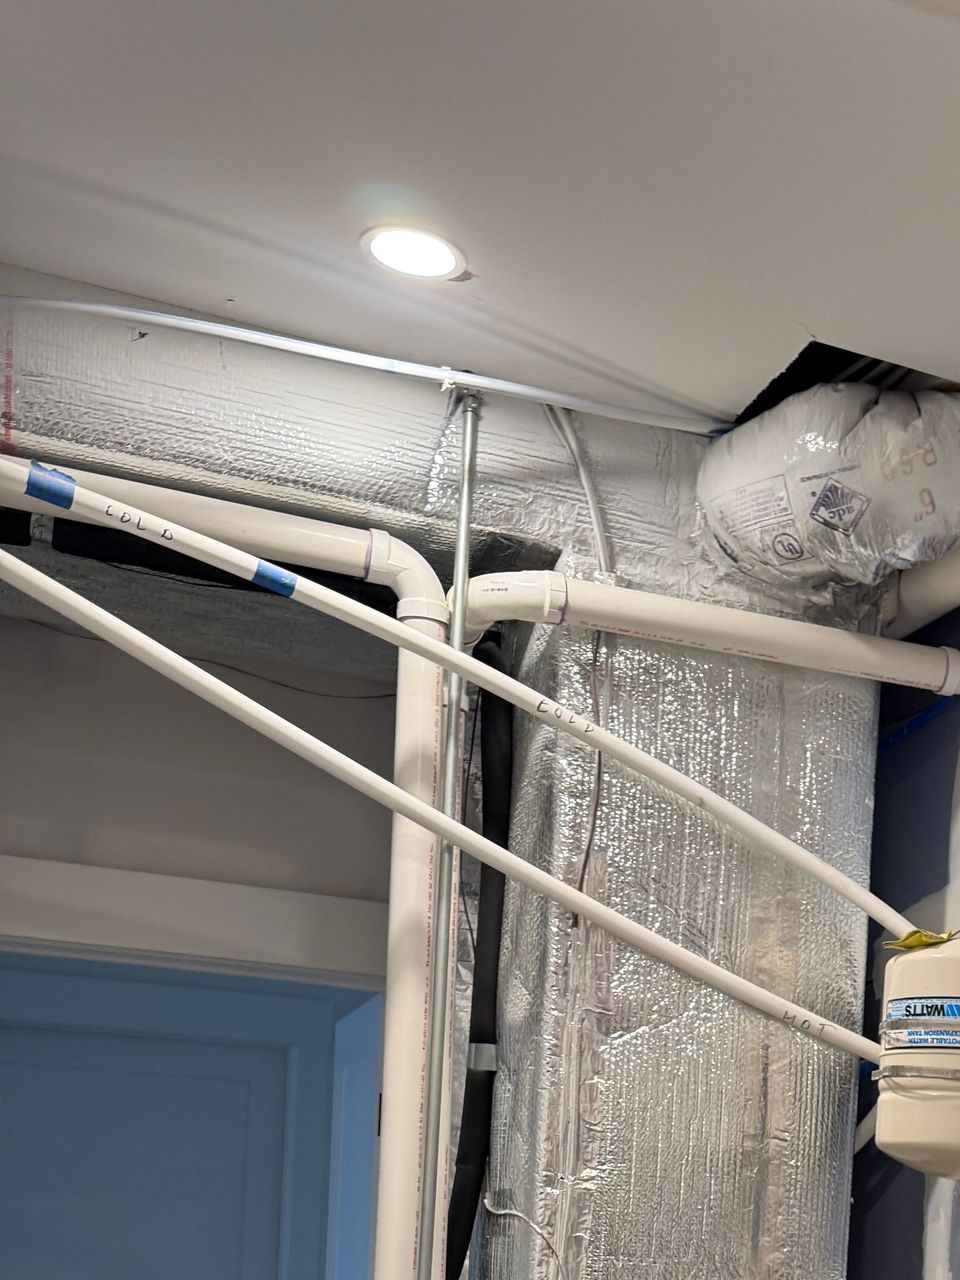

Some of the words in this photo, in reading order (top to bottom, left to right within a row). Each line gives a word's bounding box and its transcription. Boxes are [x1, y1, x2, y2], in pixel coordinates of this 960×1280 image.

[827, 504, 855, 523] adc
[904, 1004, 945, 1018] WATTS
[906, 1030, 922, 1038] TANK
[907, 1037, 929, 1045] WATER
